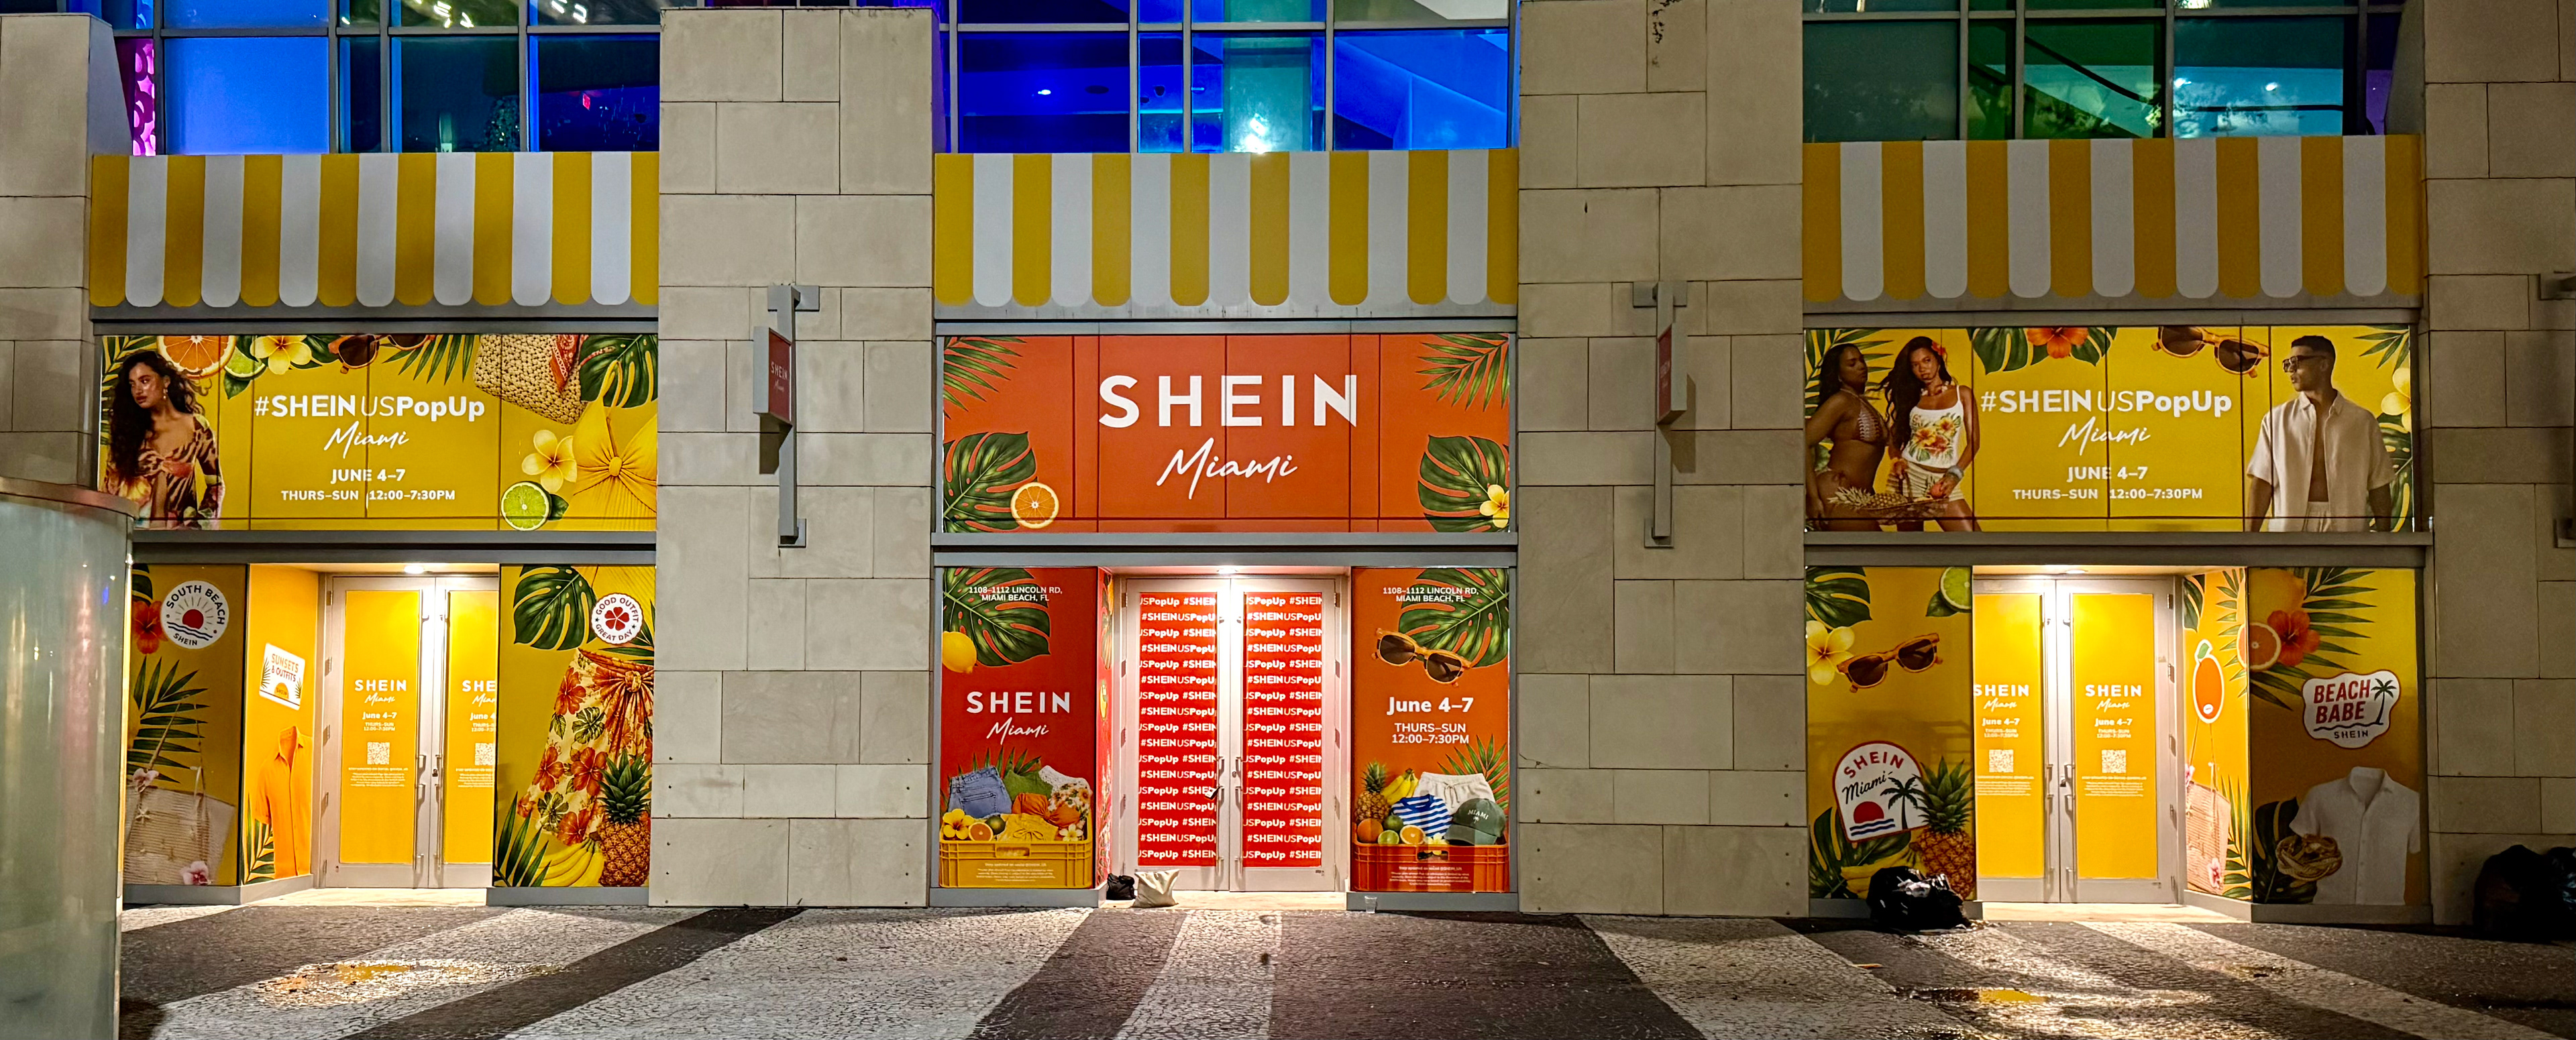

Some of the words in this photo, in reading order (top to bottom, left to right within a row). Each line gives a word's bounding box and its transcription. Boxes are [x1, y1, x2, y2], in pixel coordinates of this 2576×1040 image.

[771, 361, 788, 380] SHEIN
[1098, 373, 1357, 428] SHEIN
[323, 420, 410, 459] Miami
[2057, 416, 2151, 456] Miami
[1156, 437, 1297, 500] Miami
[2066, 466, 2112, 483] JUNE
[2117, 466, 2148, 479] 4–7
[330, 469, 372, 484] JUNE
[377, 469, 406, 481] 4–7
[281, 490, 360, 501] THURS–SUN
[369, 490, 455, 501] 12:00–7:30PM
[2012, 488, 2098, 500] THURS–SUN
[2109, 488, 2203, 500] 12:00–7:30PM
[1008, 594, 1038, 602] BEACH,
[1049, 587, 1063, 595] RD,
[1464, 587, 1479, 595] RD,
[166, 585, 202, 609] SOUTH
[205, 588, 225, 625] BEACH
[1423, 595, 1454, 603] BEACH,
[596, 597, 616, 615] GOOD
[619, 597, 639, 622] OUTFIT
[173, 633, 198, 646] SHEIN
[596, 624, 616, 641] GREAT
[618, 629, 633, 640] DAY
[271, 653, 299, 673] SUNSETS
[276, 667, 297, 682] OUTFITS
[354, 679, 407, 691] SHEIN
[1973, 684, 2029, 697] SHEIN
[2085, 684, 2142, 697] SHEIN
[2314, 679, 2371, 704] BEACH
[364, 692, 395, 706] Miami
[966, 691, 1070, 713] SHEIN
[1386, 697, 1432, 715] June
[1438, 697, 1474, 712] 4–7
[1983, 697, 2017, 712] Miami
[2096, 698, 2130, 712] Miami
[362, 711, 380, 719] June
[470, 712, 488, 721] June
[2316, 701, 2366, 724] BABE
[1394, 723, 1466, 732] THURS–SUN
[1982, 717, 2002, 726] June
[2004, 717, 2020, 726] 4–7
[2094, 718, 2114, 727] June
[986, 717, 1049, 746] Miami
[2334, 730, 2369, 739] SHEIN
[1392, 734, 1469, 744] 12:00–7:30PM
[1843, 752, 1904, 778] SHEIN
[1841, 770, 1887, 805] Miami
[1467, 809, 1489, 820] MIAMI
